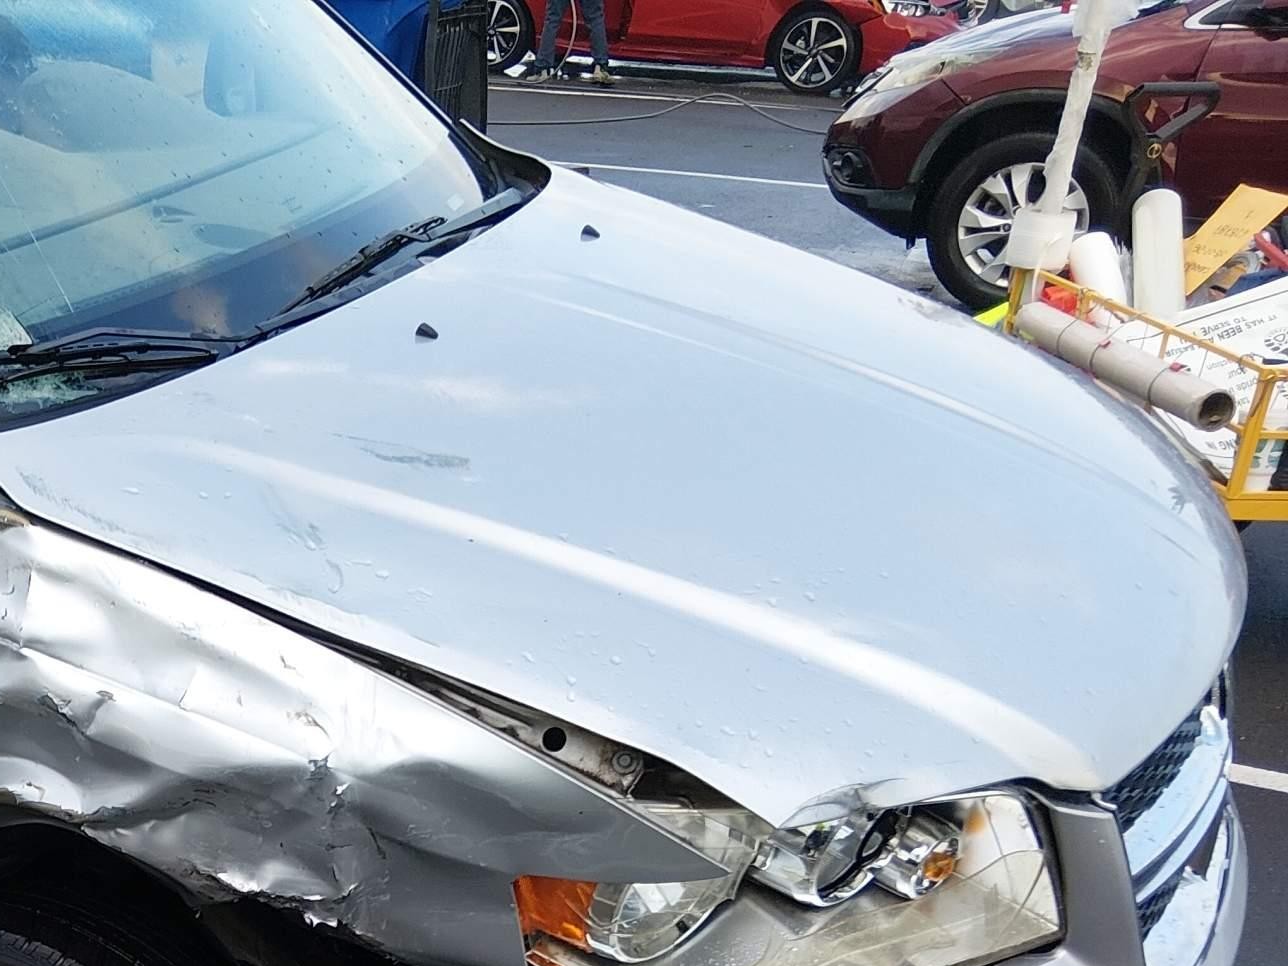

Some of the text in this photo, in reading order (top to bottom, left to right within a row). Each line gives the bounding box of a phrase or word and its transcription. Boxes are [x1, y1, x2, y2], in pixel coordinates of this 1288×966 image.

[1199, 316, 1248, 337] TO SERVE
[1244, 317, 1265, 330] HAS
[1217, 325, 1244, 341] BEEN
